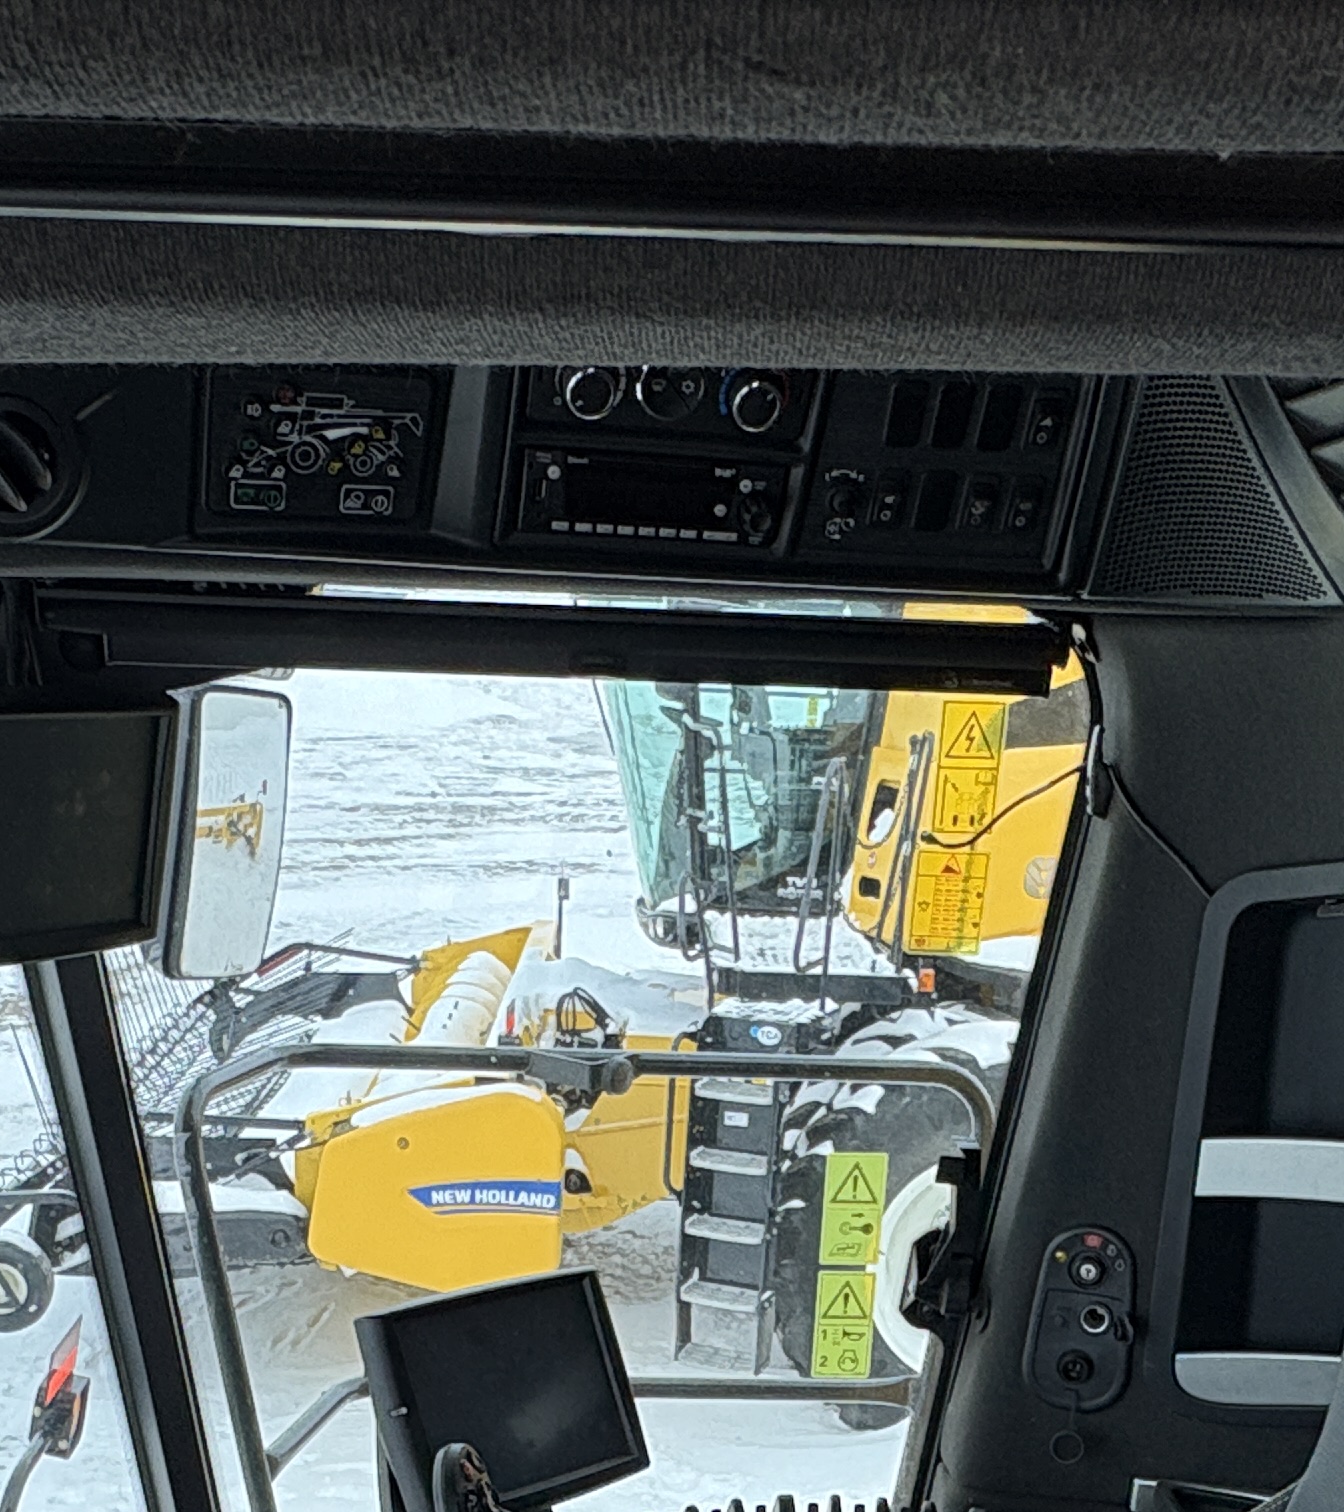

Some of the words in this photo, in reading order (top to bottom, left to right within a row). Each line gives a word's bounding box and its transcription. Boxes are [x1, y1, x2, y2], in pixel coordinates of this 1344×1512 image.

[431, 1190, 471, 1205] NEW
[474, 1189, 556, 1208] HOLLAND
[821, 1328, 827, 1341] 1
[818, 1355, 828, 1367] 2
